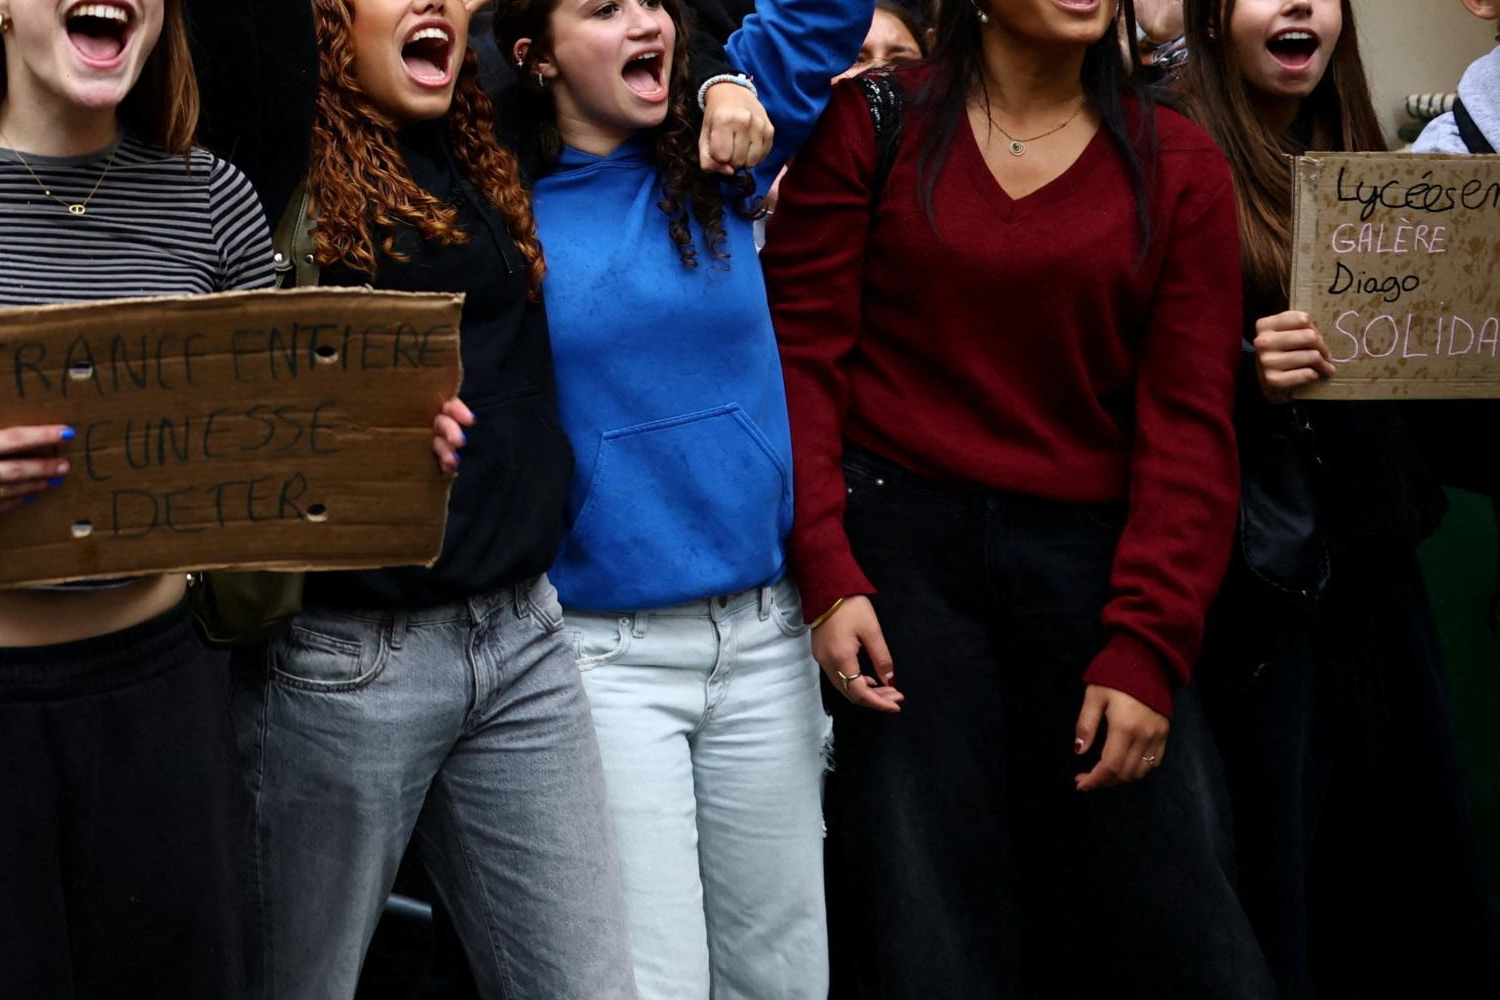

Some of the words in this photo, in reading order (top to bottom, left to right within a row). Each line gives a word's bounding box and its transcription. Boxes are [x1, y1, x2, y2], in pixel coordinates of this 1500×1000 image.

[1331, 217, 1447, 254] GALÈRE
[1328, 261, 1420, 303] Diago
[1329, 303, 1499, 364] SOLIDA
[74, 399, 341, 483] EUNESSE
[112, 472, 309, 540] DETER
